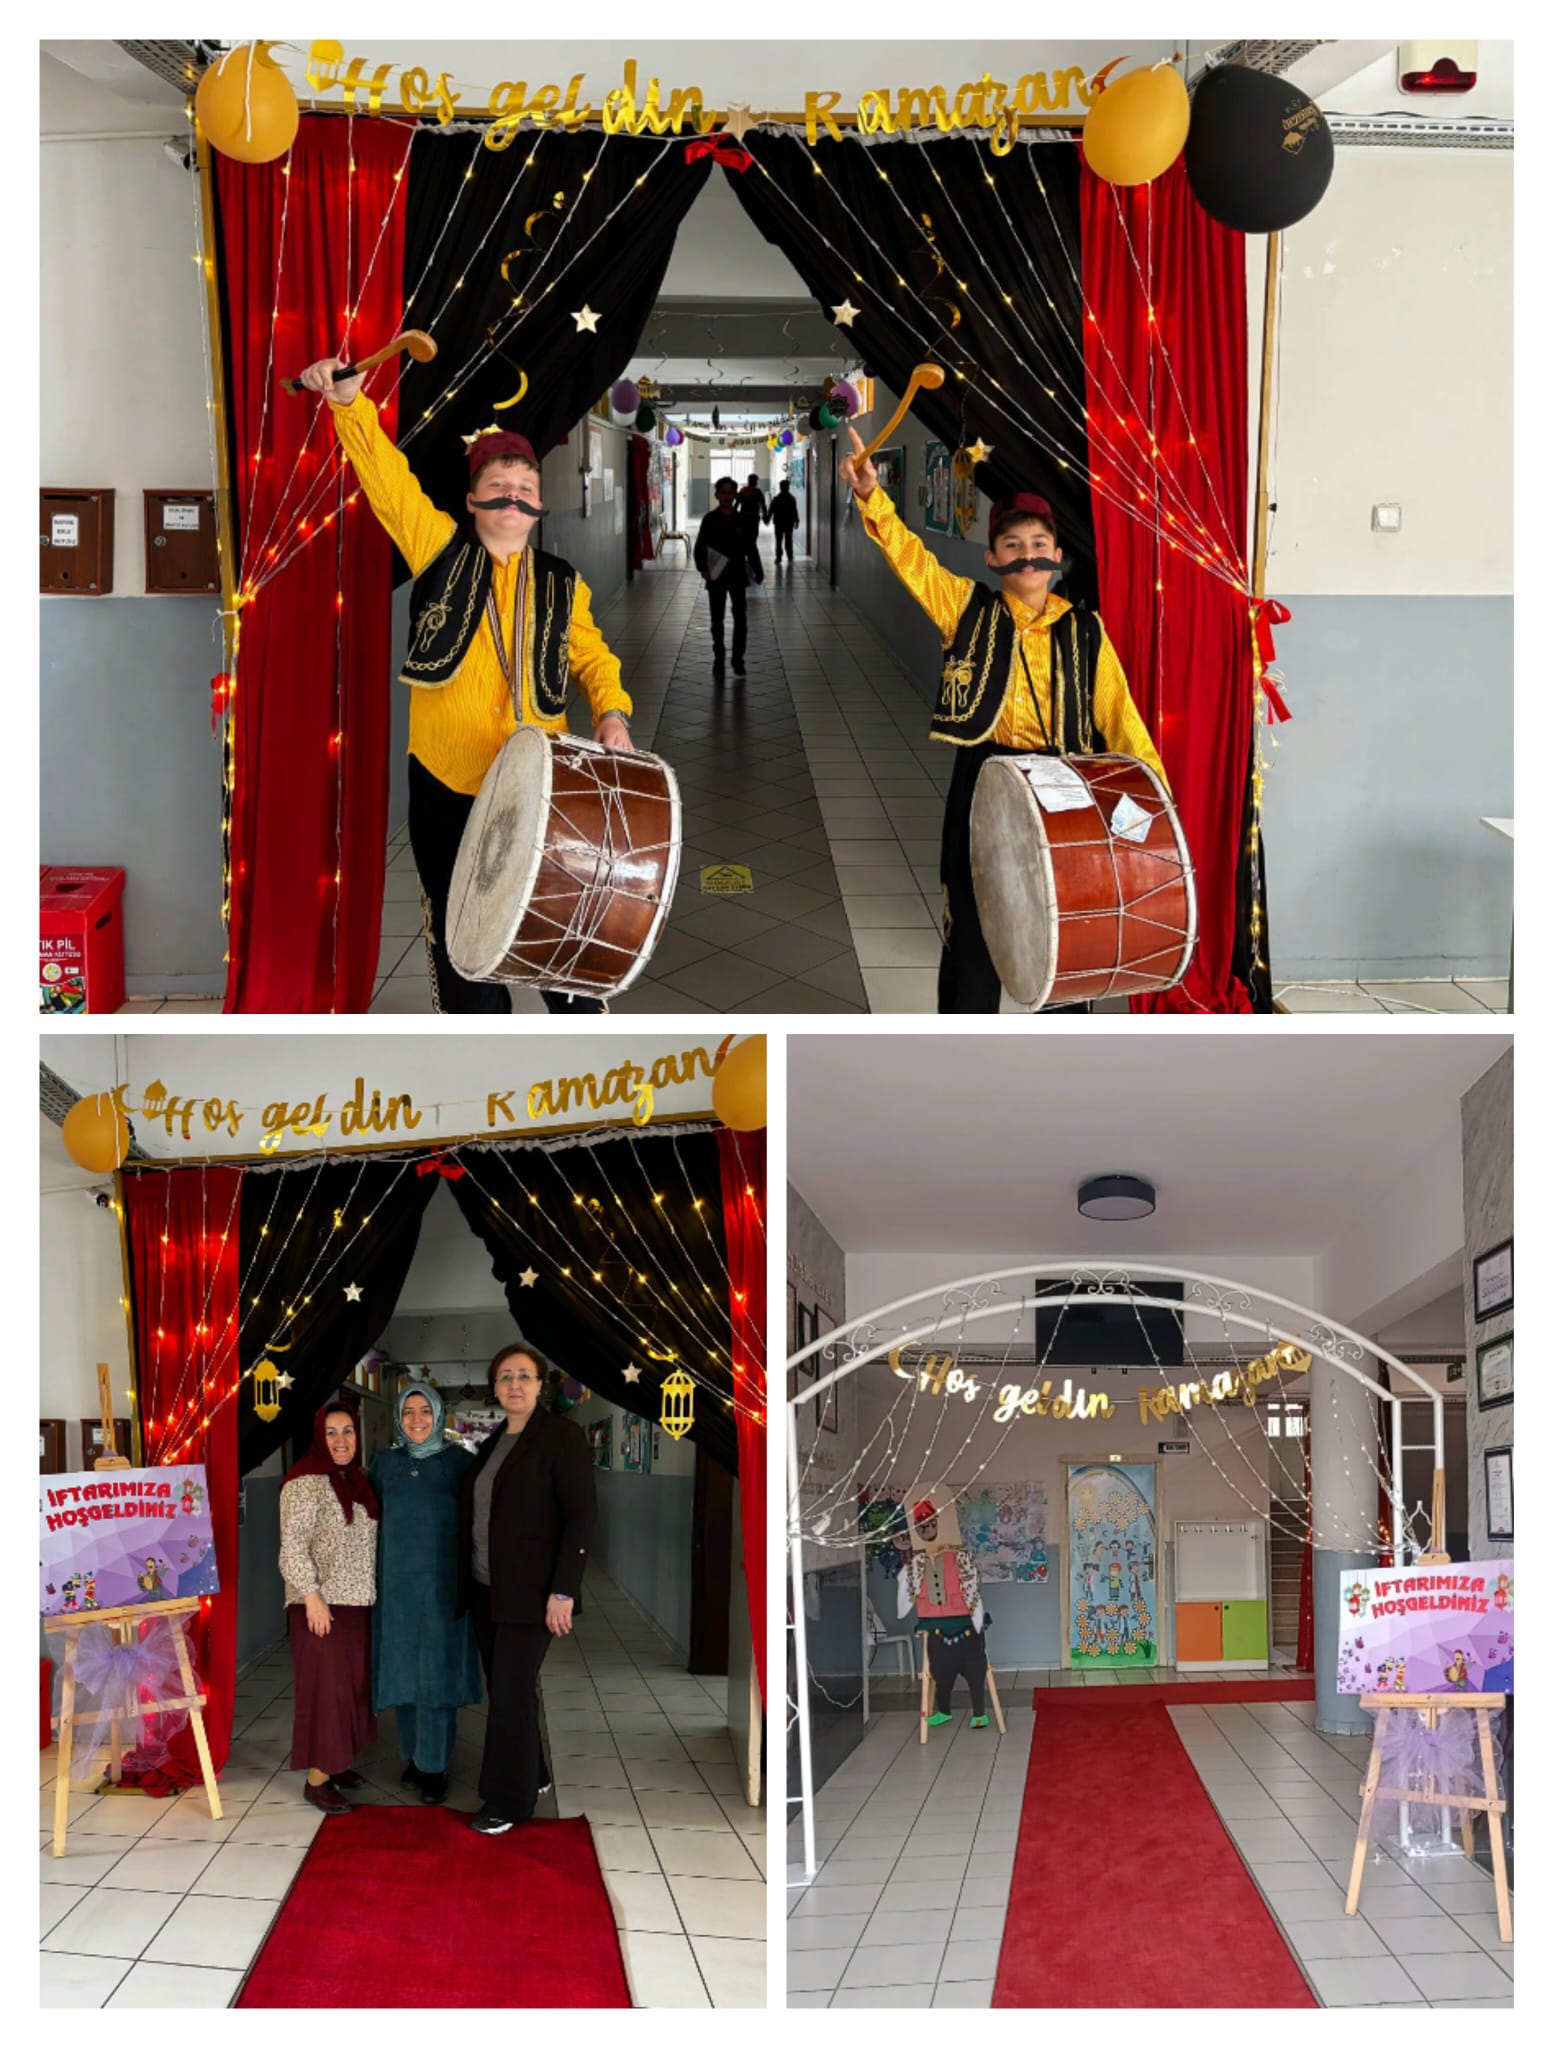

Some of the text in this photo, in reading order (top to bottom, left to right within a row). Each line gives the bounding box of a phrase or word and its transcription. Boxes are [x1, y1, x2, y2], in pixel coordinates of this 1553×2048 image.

[47, 1482, 171, 1507] İFTARIMIZA
[46, 1500, 177, 1532] HOŞGELDİNİZ
[1374, 1576, 1485, 1597] İFTARIMIZA
[1372, 1594, 1489, 1619] HOŞGELDİNİZ
